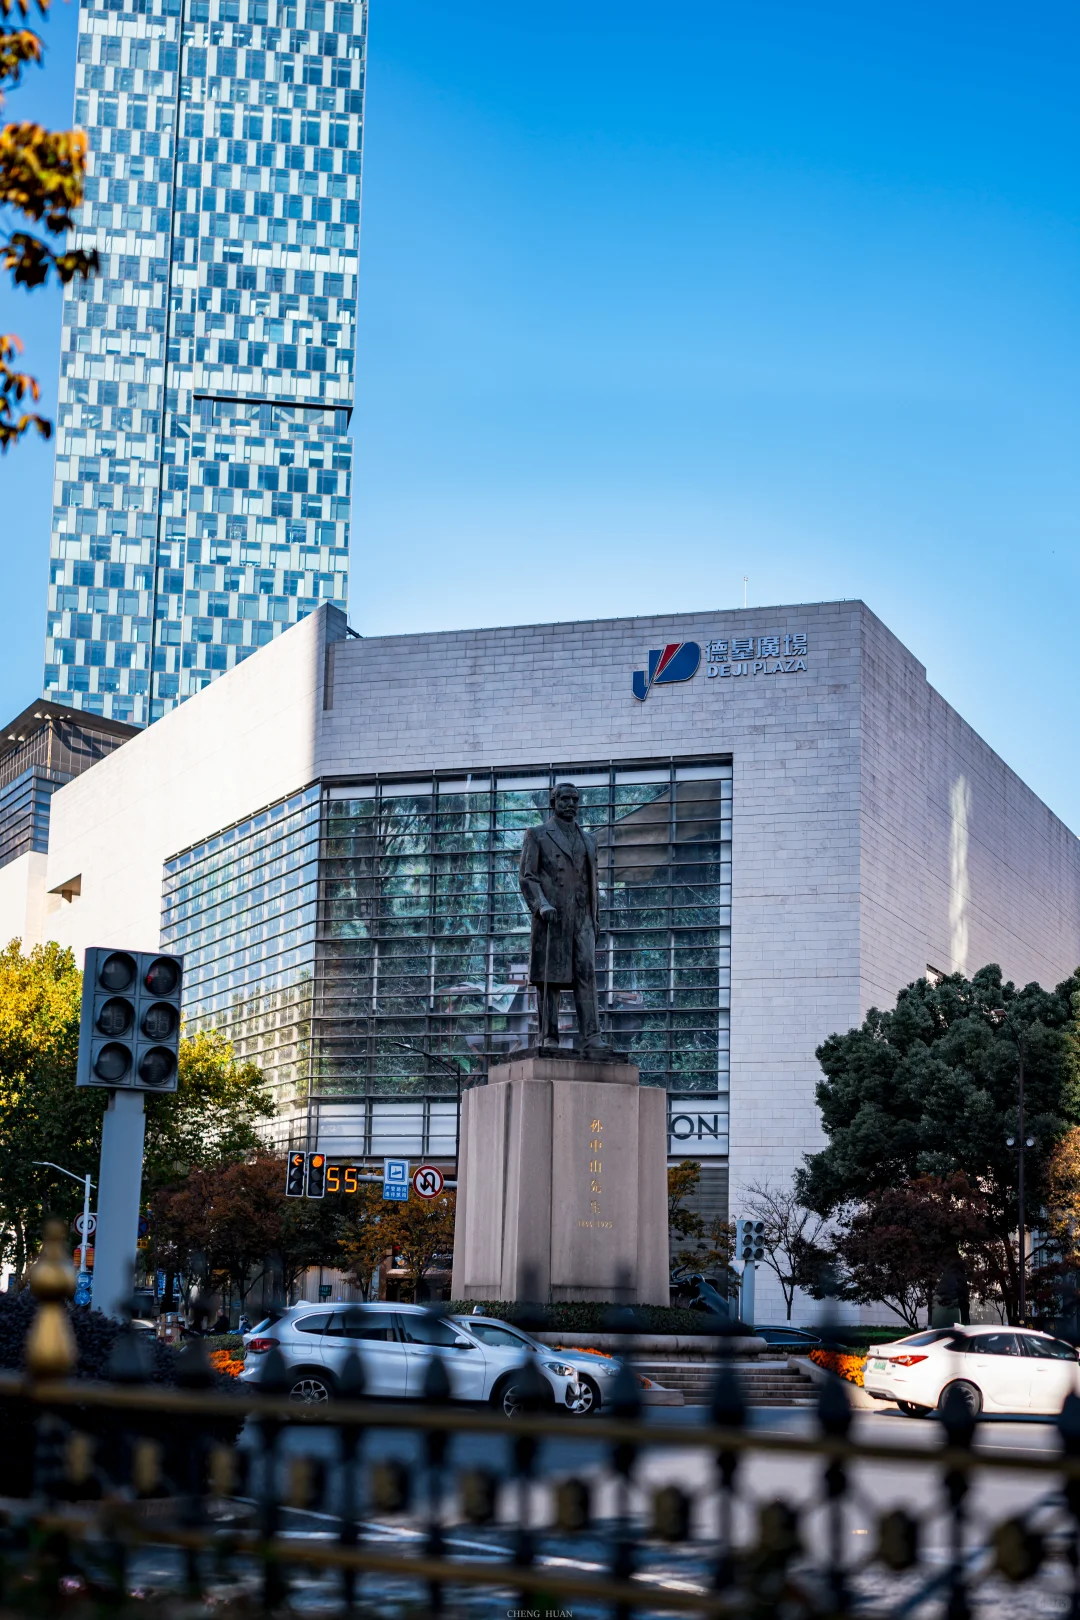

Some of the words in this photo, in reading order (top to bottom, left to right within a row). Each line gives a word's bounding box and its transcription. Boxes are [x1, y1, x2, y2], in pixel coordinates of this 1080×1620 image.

[705, 633, 807, 663] 德基廣場
[707, 663, 748, 678] DEJI
[753, 659, 807, 675] PLAZA
[326, 1167, 358, 1193] 55
